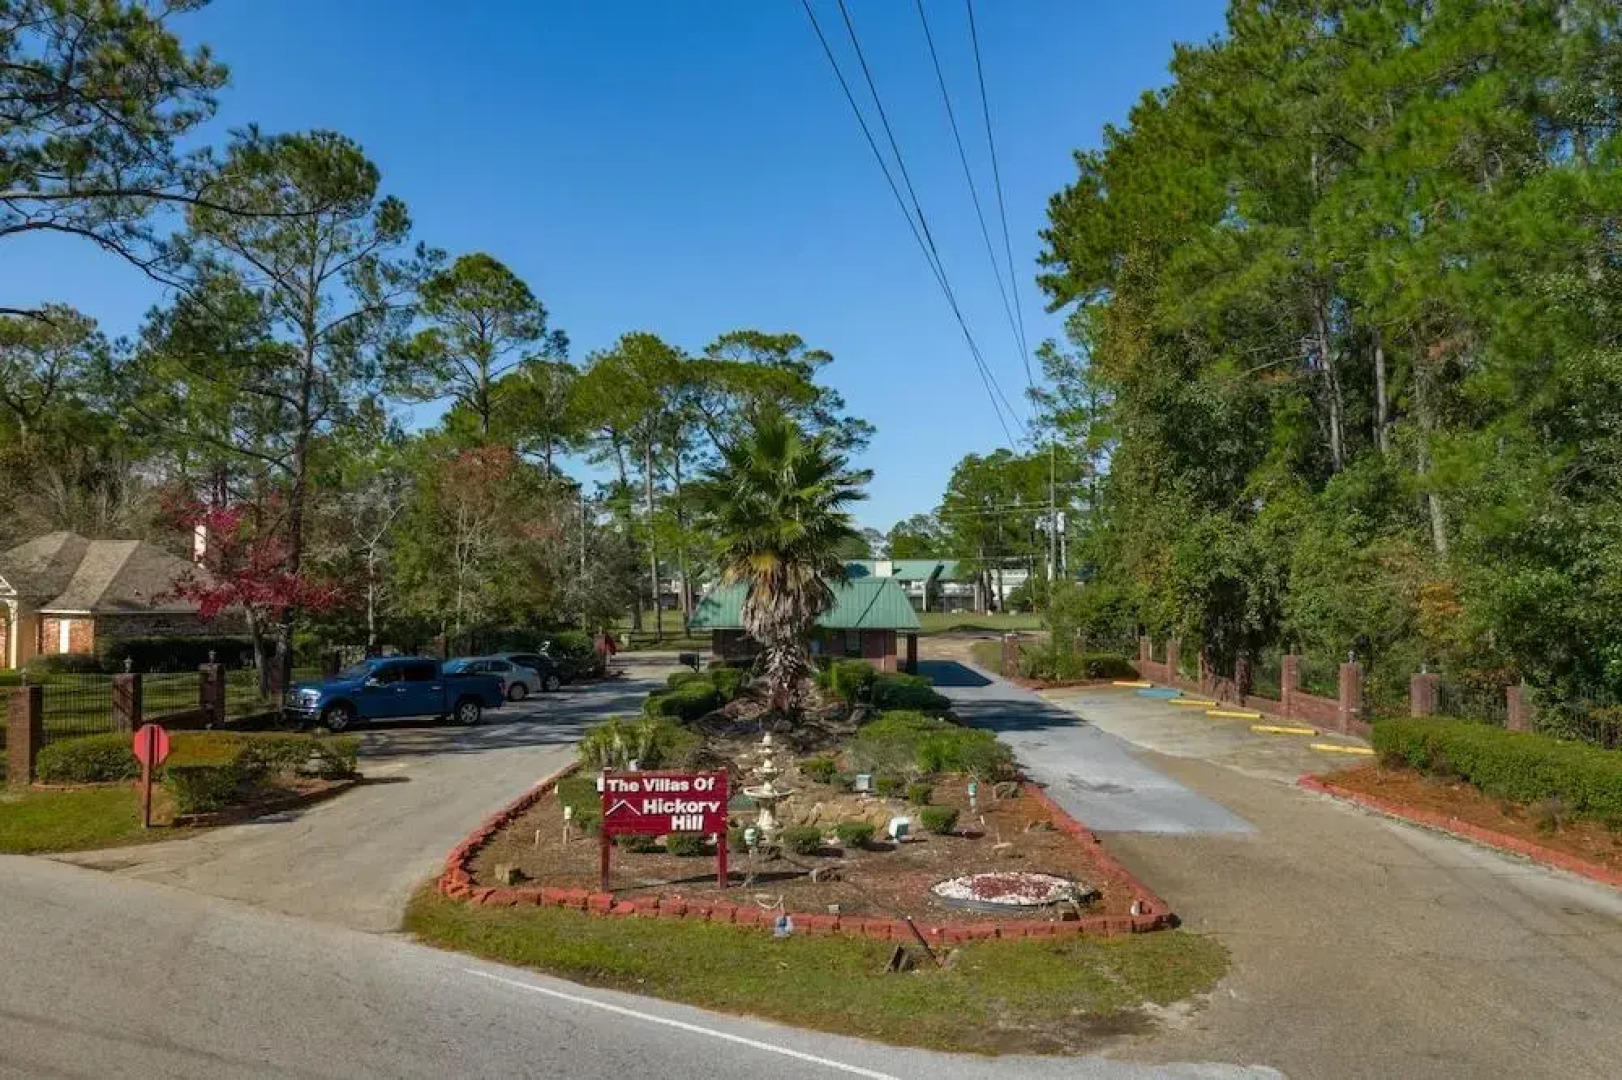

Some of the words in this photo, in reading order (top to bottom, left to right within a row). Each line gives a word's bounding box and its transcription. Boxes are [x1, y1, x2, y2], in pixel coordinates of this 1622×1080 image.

[606, 779, 640, 792] The
[643, 778, 689, 792] Villas
[694, 777, 715, 791] Of
[642, 799, 720, 814] Hickory
[671, 815, 704, 831] Hill
